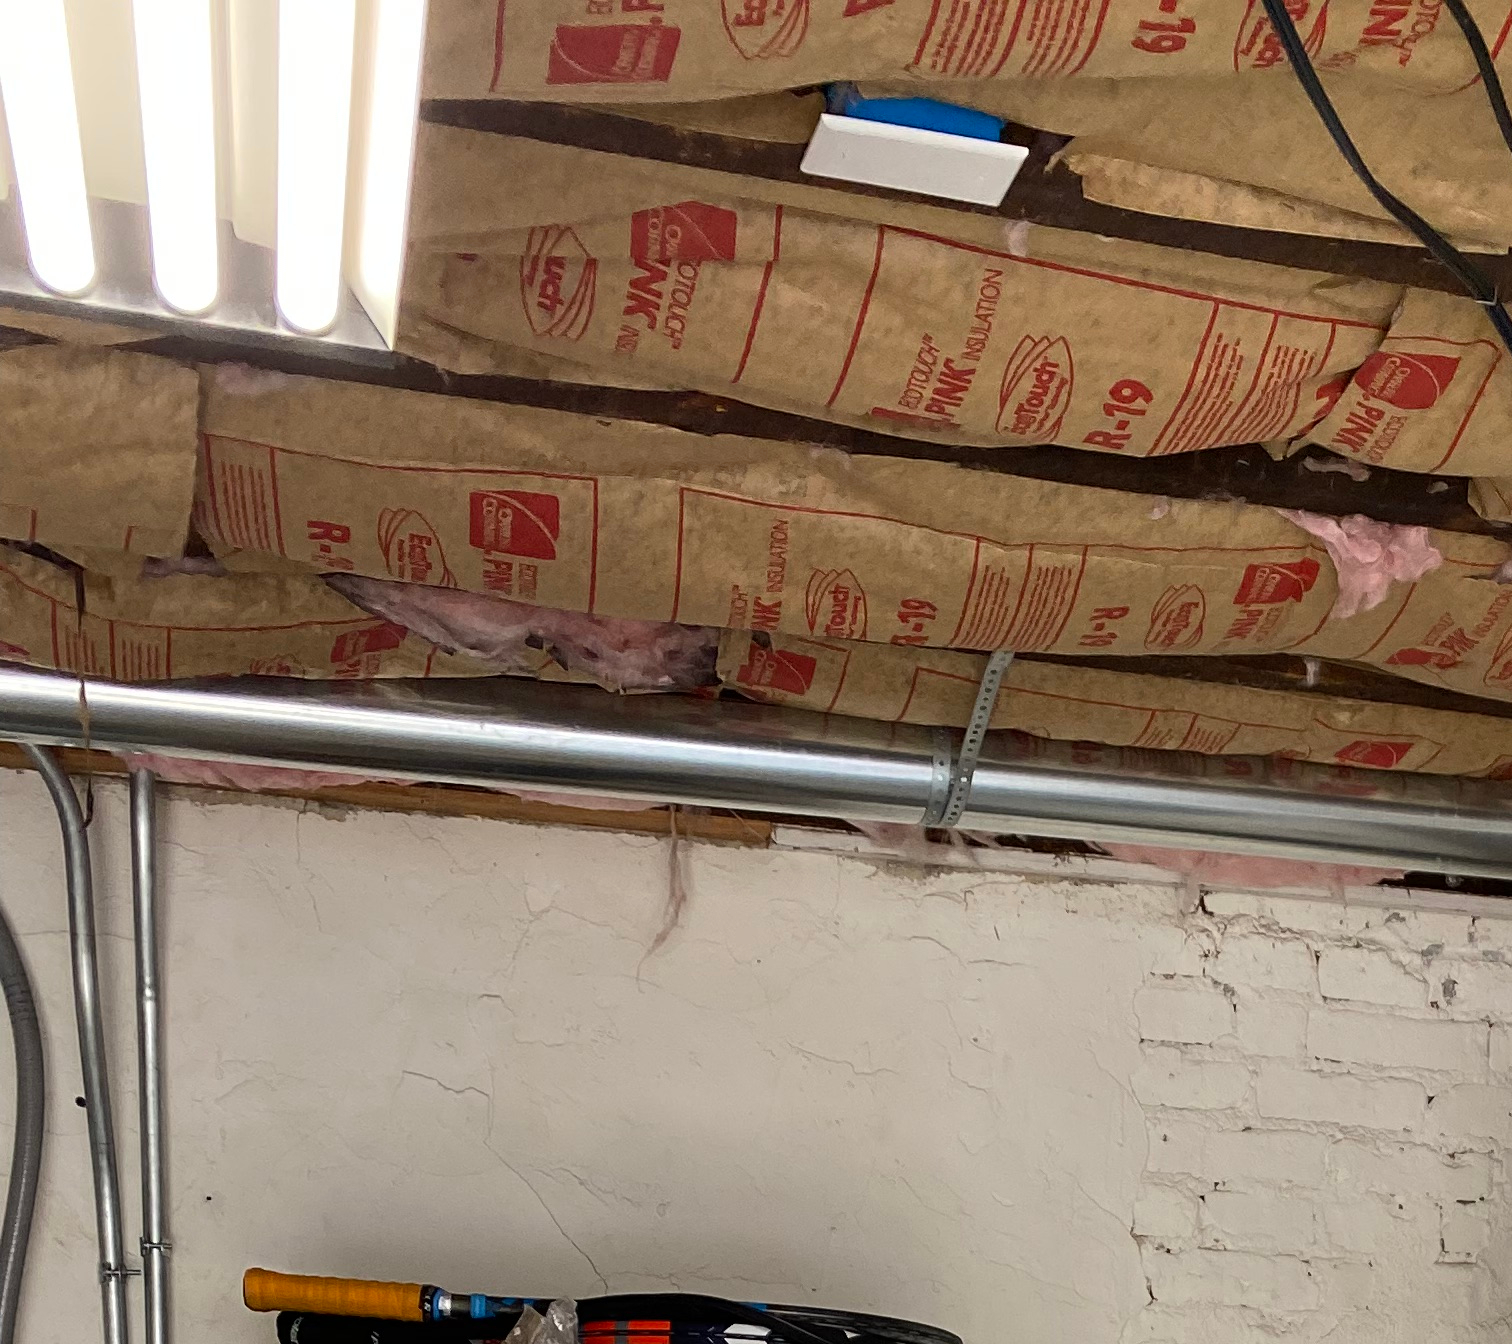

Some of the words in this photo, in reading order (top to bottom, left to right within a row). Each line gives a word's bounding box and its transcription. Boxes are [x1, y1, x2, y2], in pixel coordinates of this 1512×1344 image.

[1131, 0, 1197, 54] -19
[924, 358, 977, 418] PINK
[962, 268, 1004, 362] INSULATION
[1082, 378, 1154, 450] R-19
[1331, 400, 1386, 454] PINK
